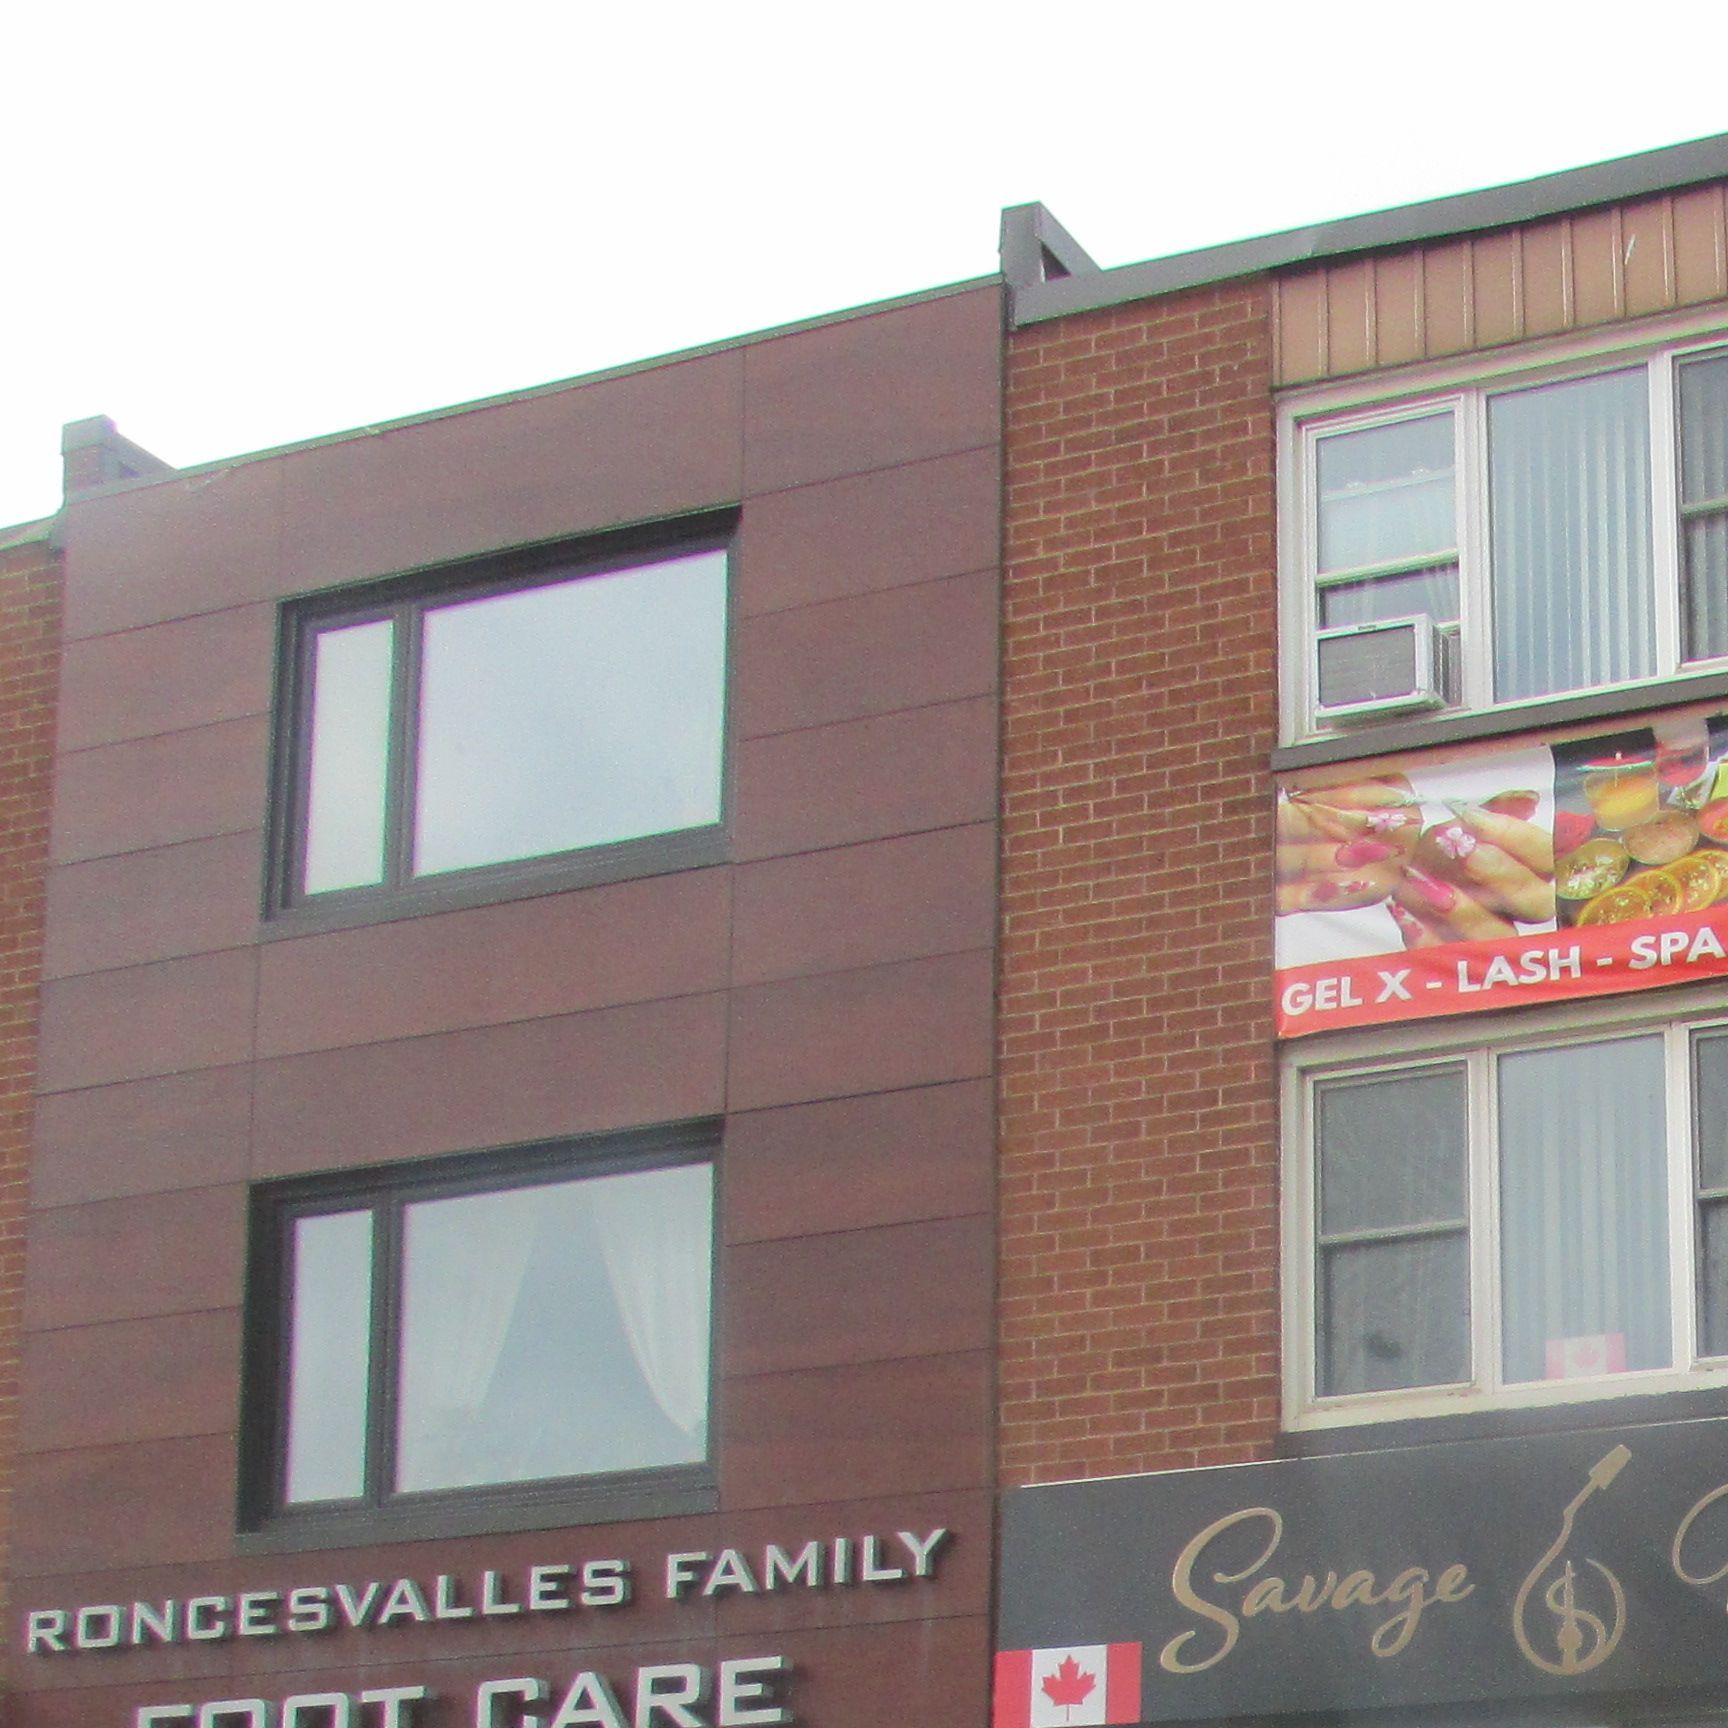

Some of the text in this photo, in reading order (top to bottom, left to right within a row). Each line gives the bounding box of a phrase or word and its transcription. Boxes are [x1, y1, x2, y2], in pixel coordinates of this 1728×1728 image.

[1281, 977, 1362, 1017] GEL
[1374, 969, 1411, 1003] X
[1457, 945, 1583, 993] LASH
[1630, 925, 1726, 971] SPA
[27, 1528, 949, 1653] RONCESVALLES FAMILY
[1160, 1507, 1474, 1673] Savage
